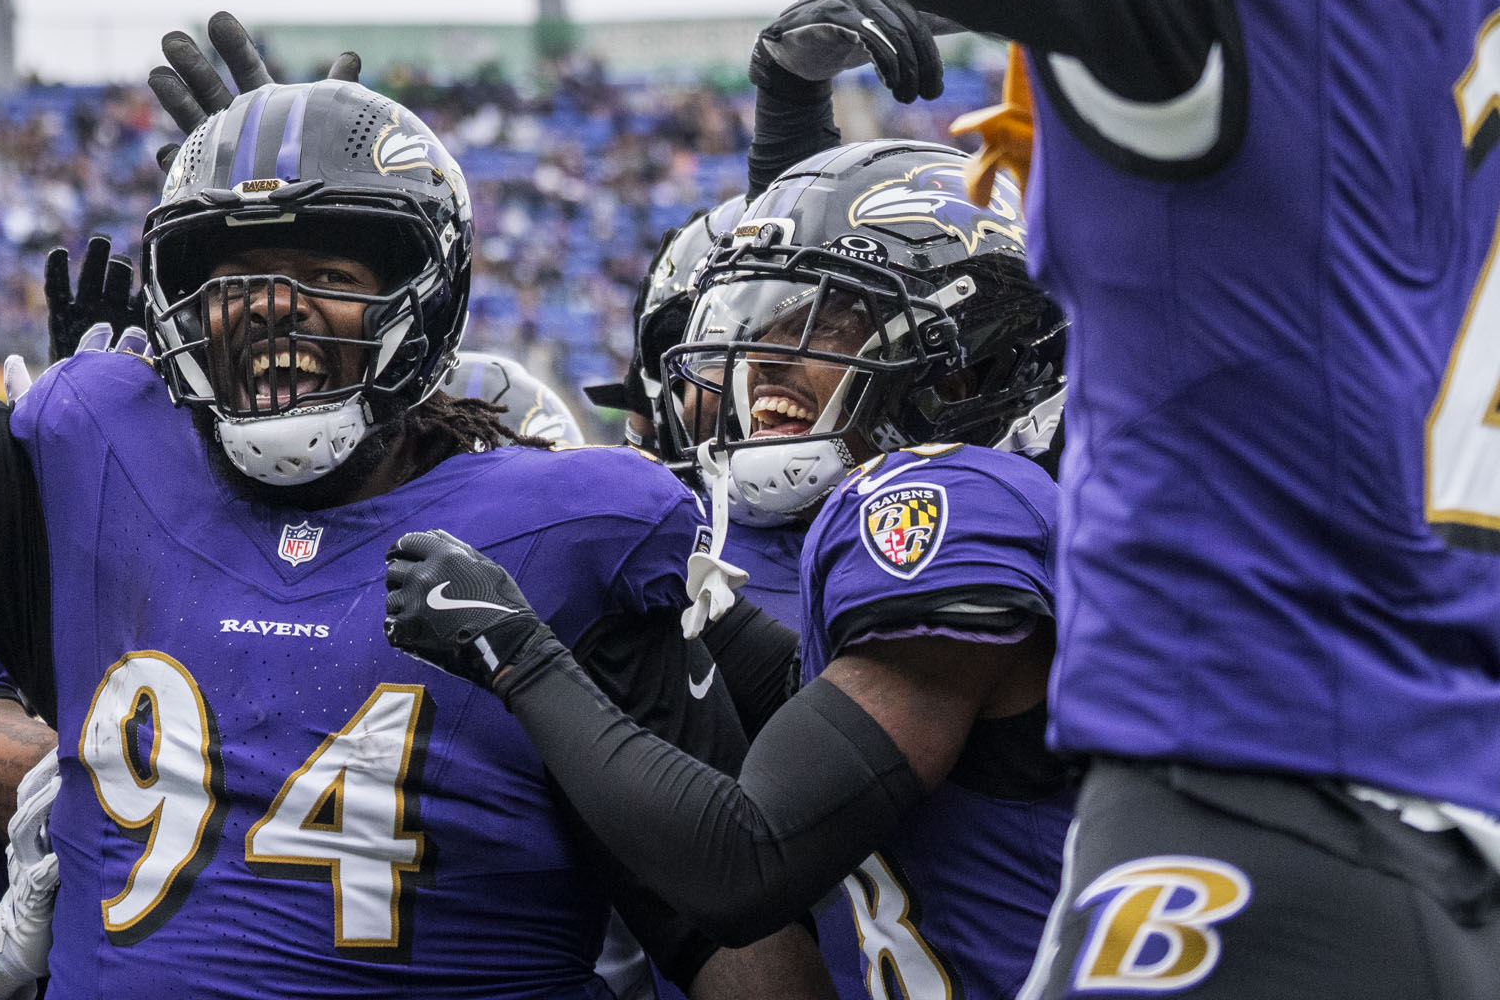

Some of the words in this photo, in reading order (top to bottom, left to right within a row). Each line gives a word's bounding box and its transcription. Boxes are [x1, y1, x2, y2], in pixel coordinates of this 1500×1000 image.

[242, 180, 280, 193] RAVENS
[830, 247, 885, 263] OAKLEY
[868, 489, 934, 513] RAVENS
[284, 538, 310, 558] NFL
[220, 619, 330, 638] RAVENS
[78, 649, 438, 949] 94
[1074, 855, 1254, 993] B
